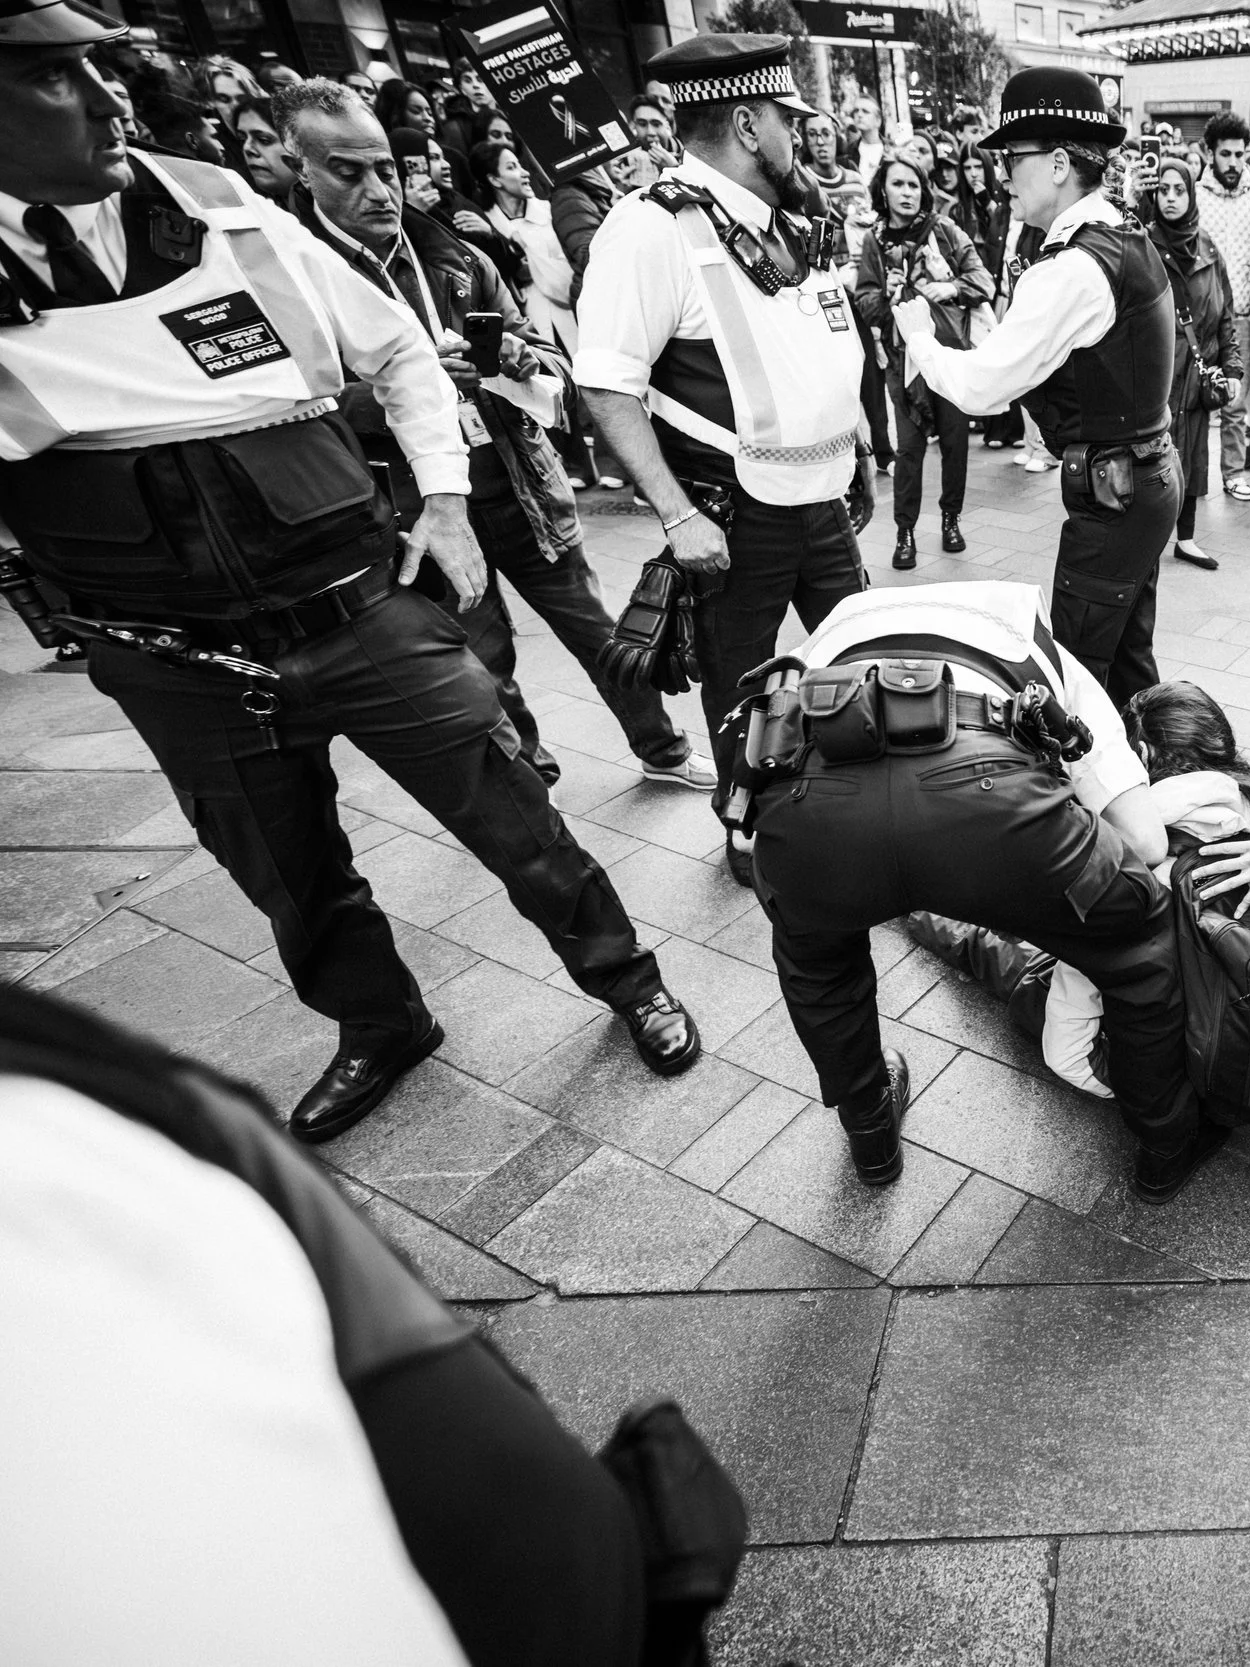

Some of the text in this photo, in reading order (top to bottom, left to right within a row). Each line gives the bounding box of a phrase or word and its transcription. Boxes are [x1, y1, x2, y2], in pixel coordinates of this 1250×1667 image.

[482, 31, 564, 70] FREE PALESTINIAN
[491, 43, 572, 84] HOSTAGES
[547, 60, 583, 85] الحرية
[183, 302, 232, 321] SERGEANT
[199, 312, 228, 326] WOOD
[228, 333, 263, 350] POLICE
[205, 343, 283, 372] POLICE OFFICER
